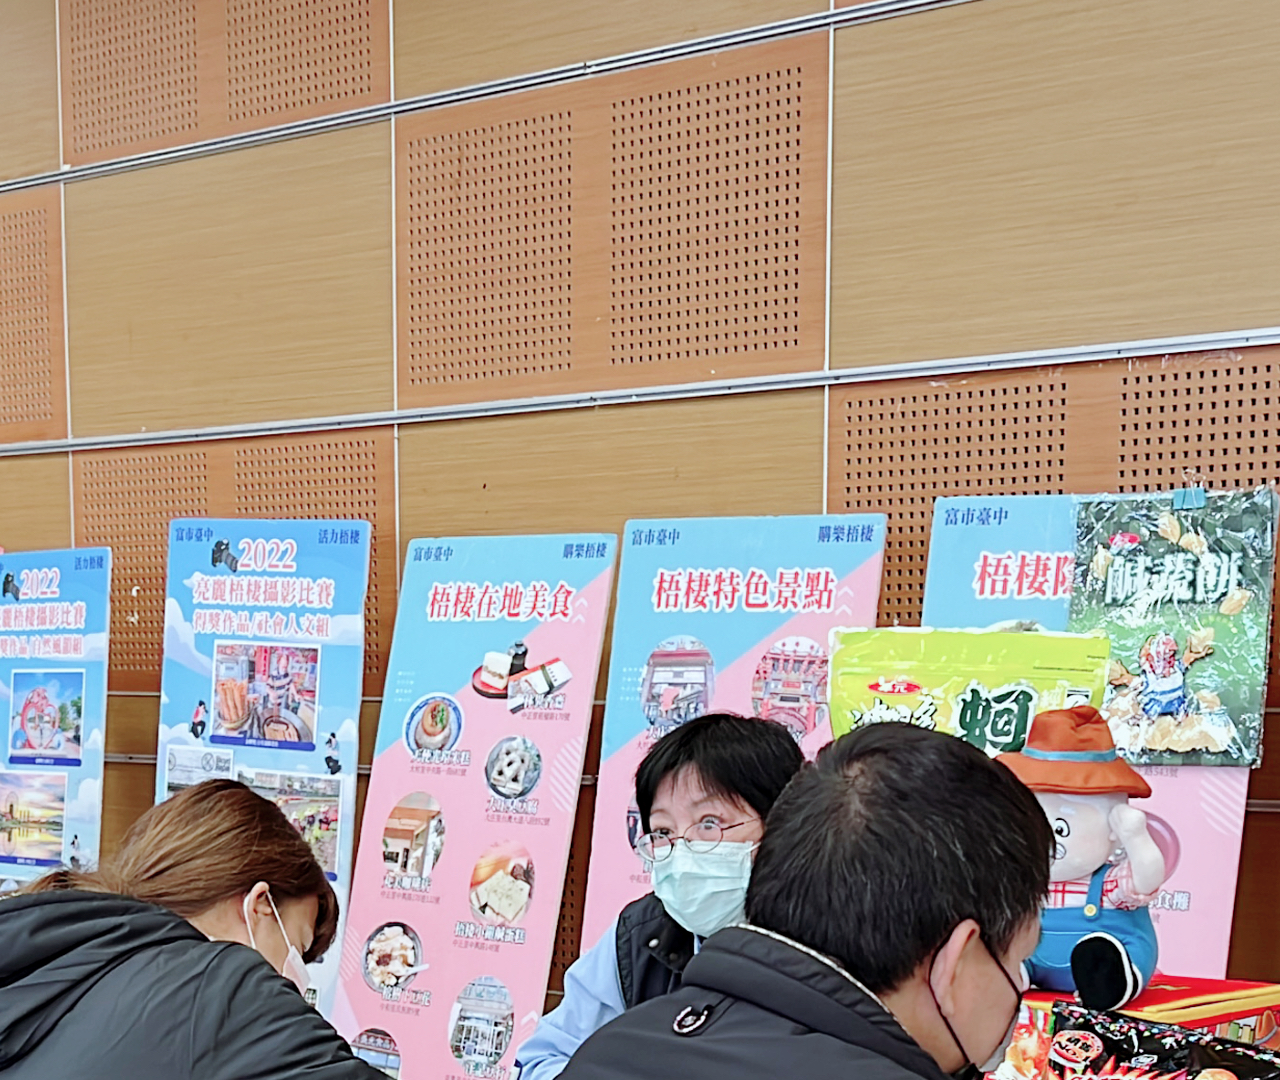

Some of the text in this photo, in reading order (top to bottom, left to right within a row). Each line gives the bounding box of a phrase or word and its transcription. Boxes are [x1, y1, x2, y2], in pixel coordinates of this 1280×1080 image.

[945, 507, 1008, 525] 富市臺中
[175, 528, 360, 544] 富市臺中 活力梧棲
[632, 525, 873, 545] 富市臺中 購樂梧棲
[239, 542, 296, 569] 2022
[414, 546, 453, 562] 富市臺中
[20, 569, 59, 597] 2022
[194, 578, 333, 607] 亮麗梧棲攝影比賽
[656, 570, 836, 610] 梧棲特色景點
[429, 584, 574, 619] 梧棲在地美食
[1149, 891, 1191, 910] 食攤
